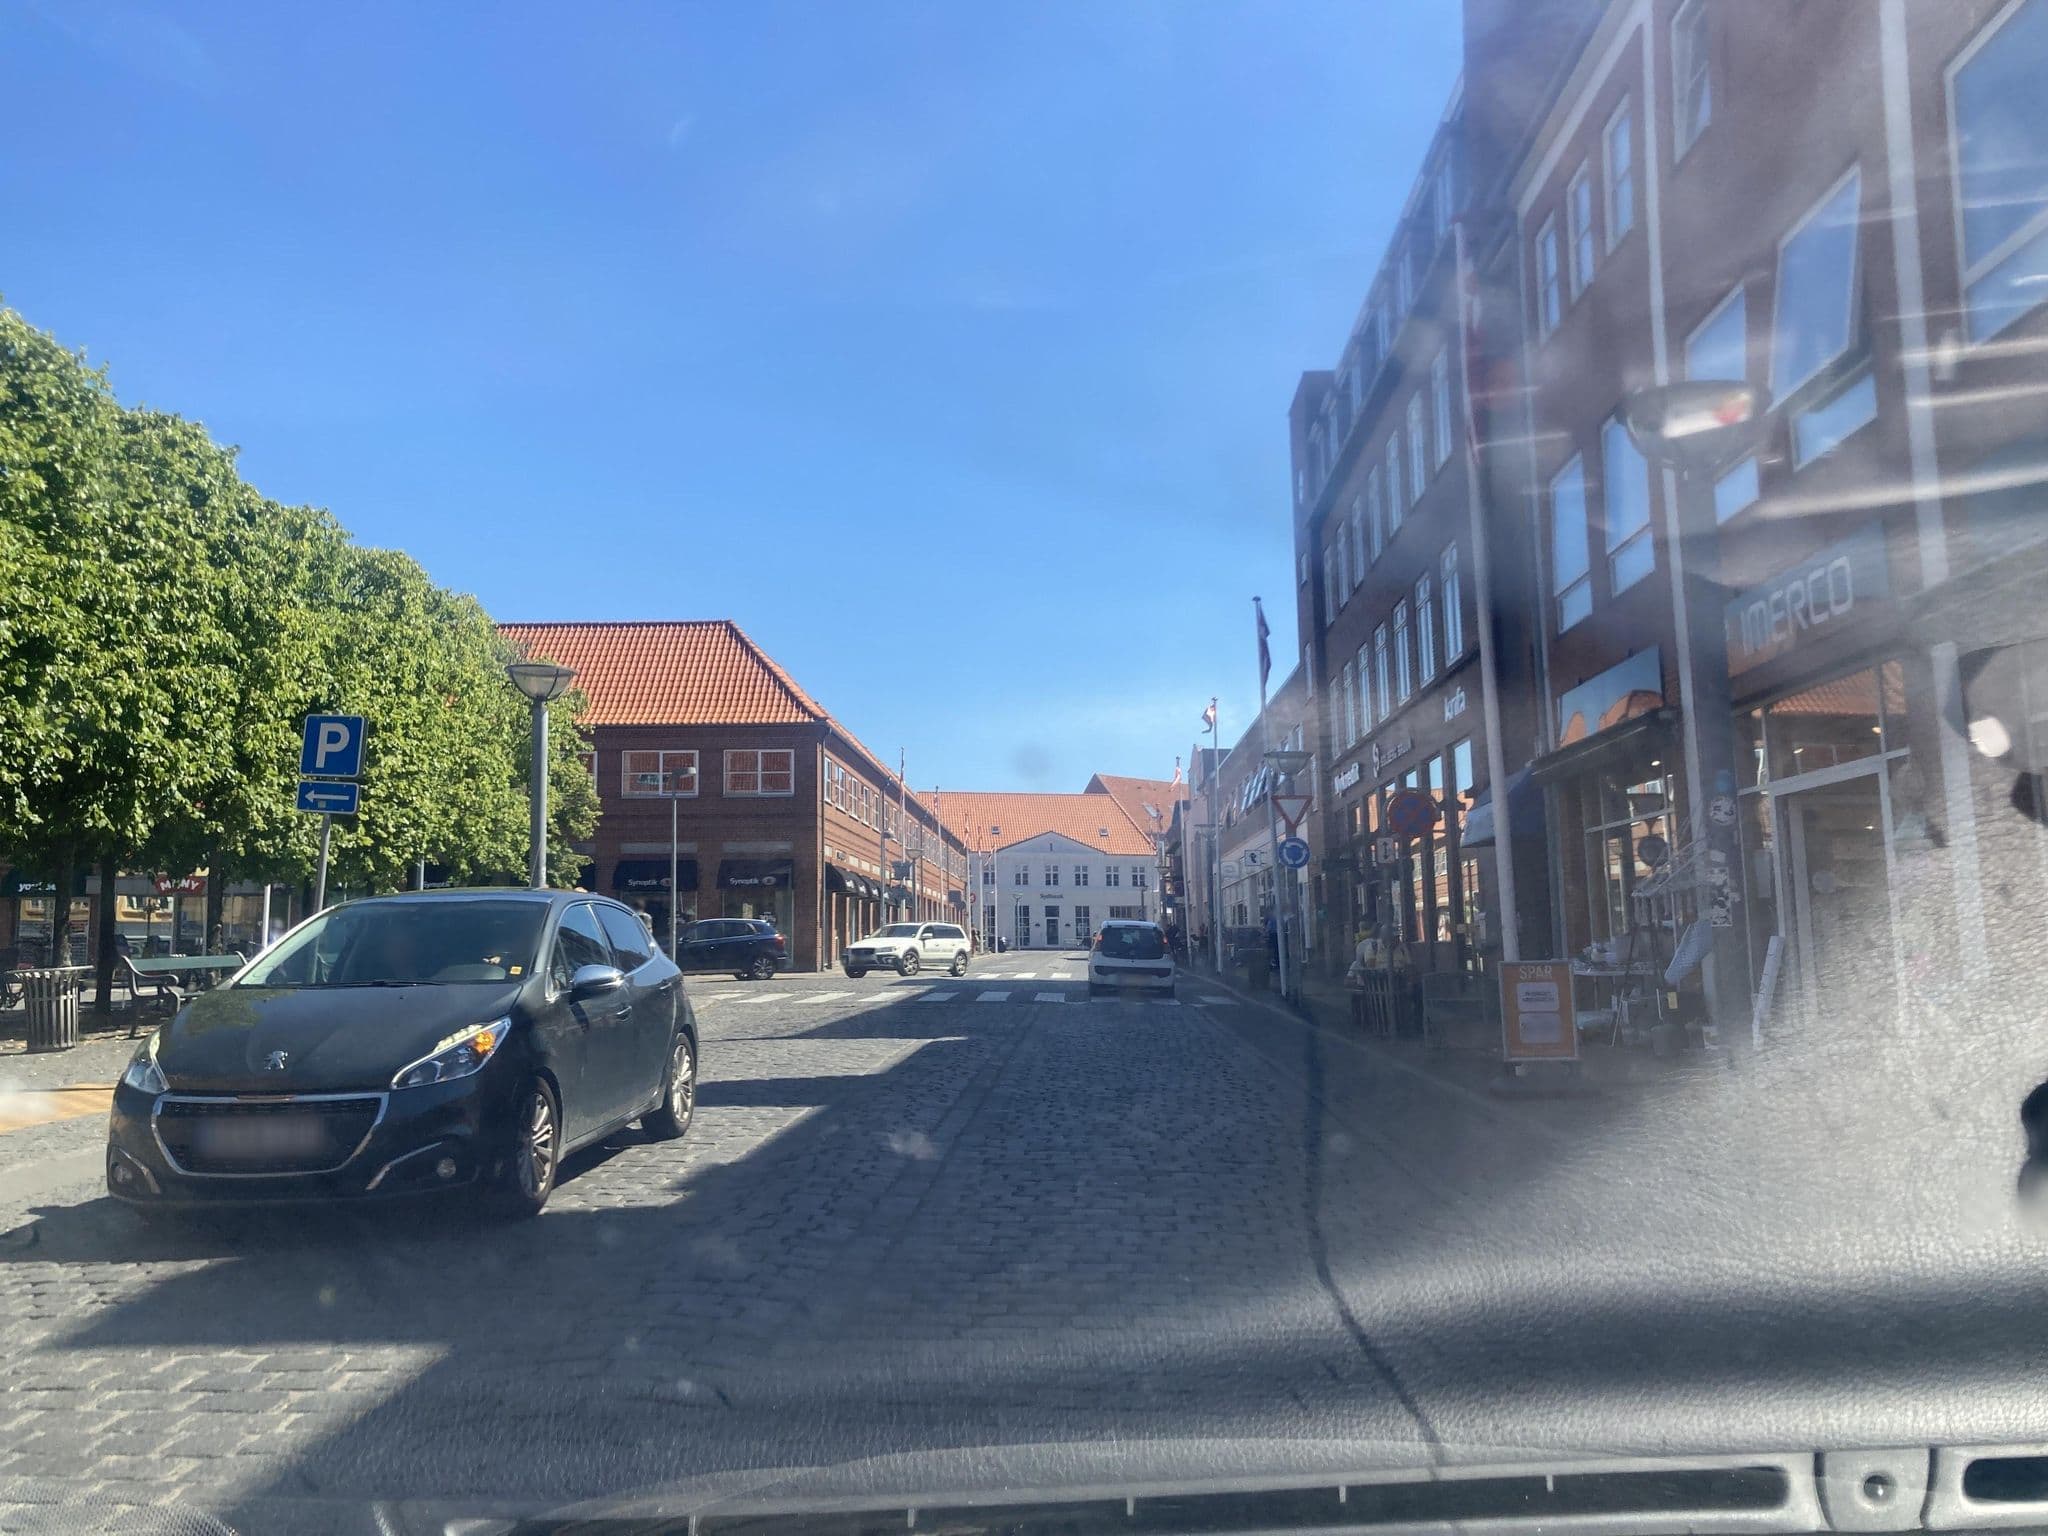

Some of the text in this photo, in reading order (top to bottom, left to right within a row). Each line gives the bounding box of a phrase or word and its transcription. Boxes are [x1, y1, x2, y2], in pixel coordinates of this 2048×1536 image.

[1741, 556, 1853, 656] IMERCO
[315, 722, 350, 768] P
[1520, 965, 1552, 980] SPAR
